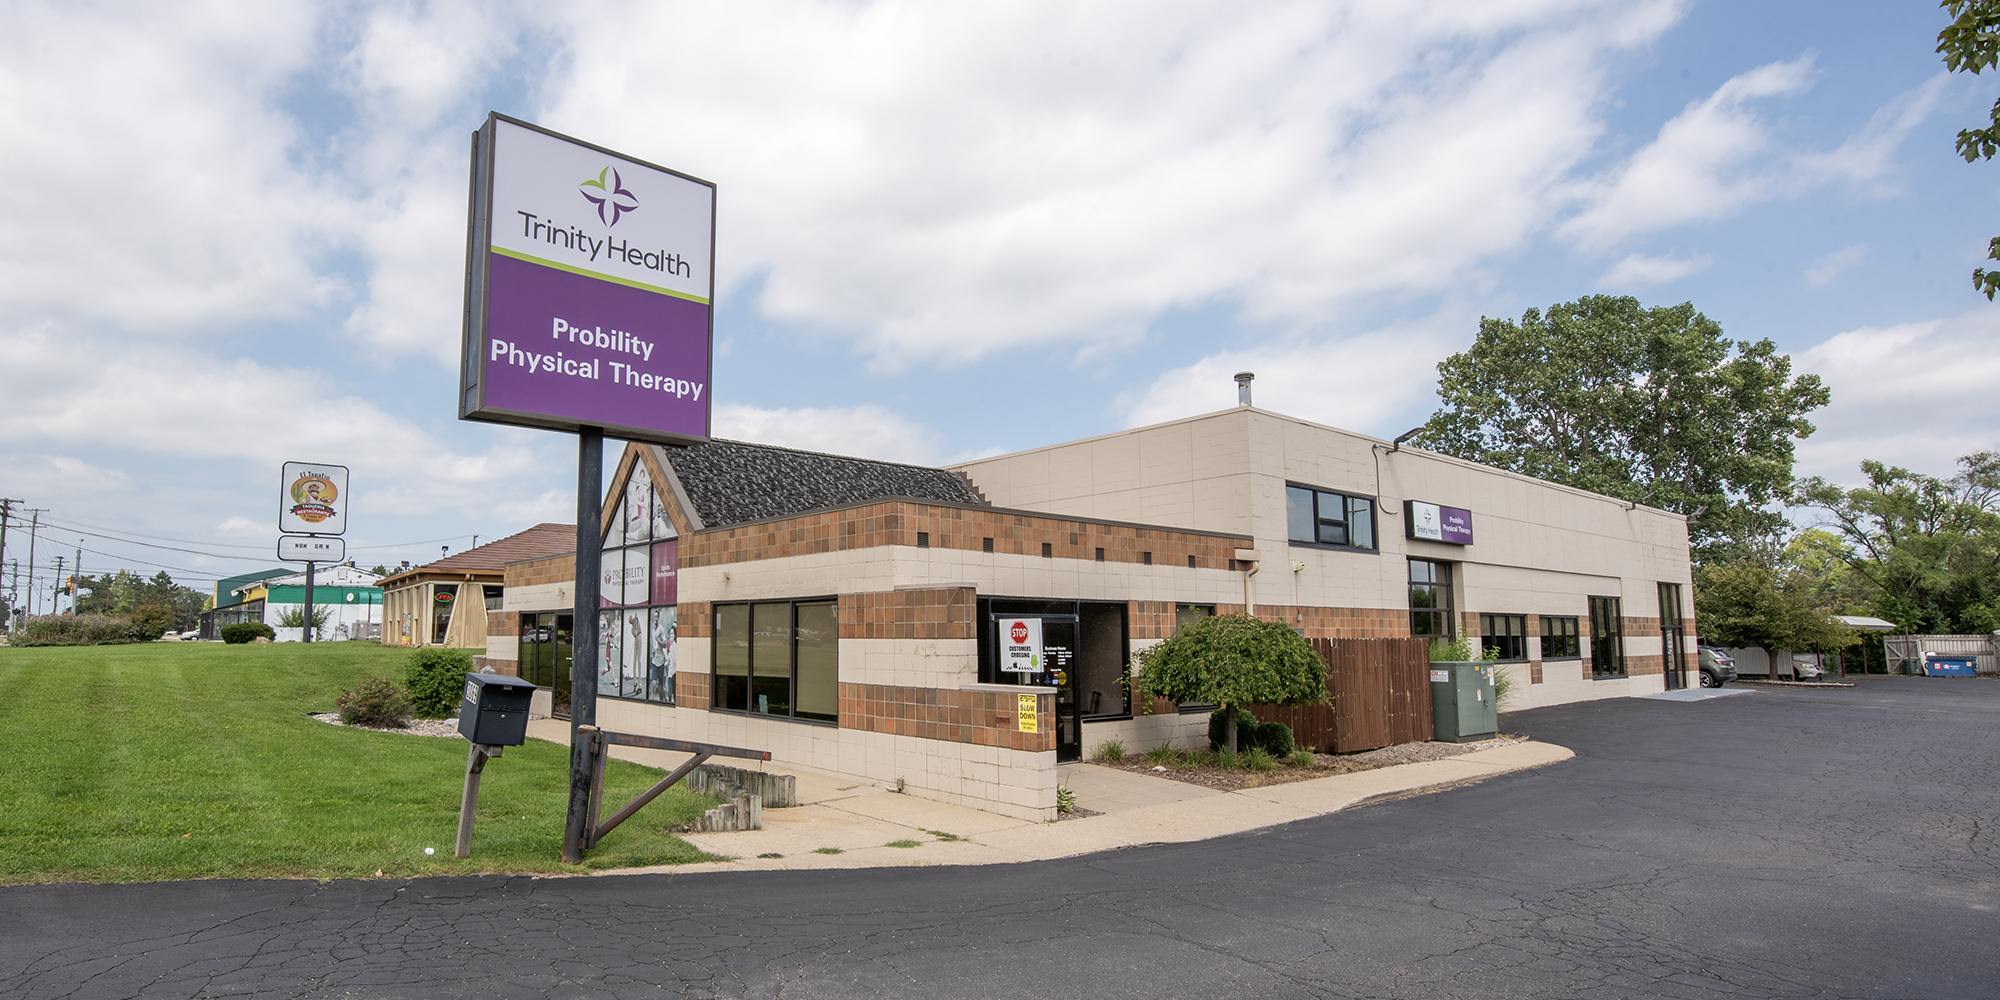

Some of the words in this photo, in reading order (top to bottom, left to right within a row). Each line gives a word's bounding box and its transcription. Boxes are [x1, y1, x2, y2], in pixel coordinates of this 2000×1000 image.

[517, 210, 603, 261] Trinity
[607, 236, 691, 278] Health
[552, 317, 654, 361] Probility
[491, 338, 599, 380] Physical
[608, 361, 703, 401] Therapy
[299, 471, 306, 479] El
[1416, 524, 1428, 536] Trinity
[1442, 524, 1457, 533] Physical
[1458, 525, 1471, 535] Therapy
[436, 593, 452, 601] OPEN
[1012, 628, 1027, 638] STOP
[1020, 704, 1035, 712] SLOW
[1020, 712, 1036, 720] DOWN
